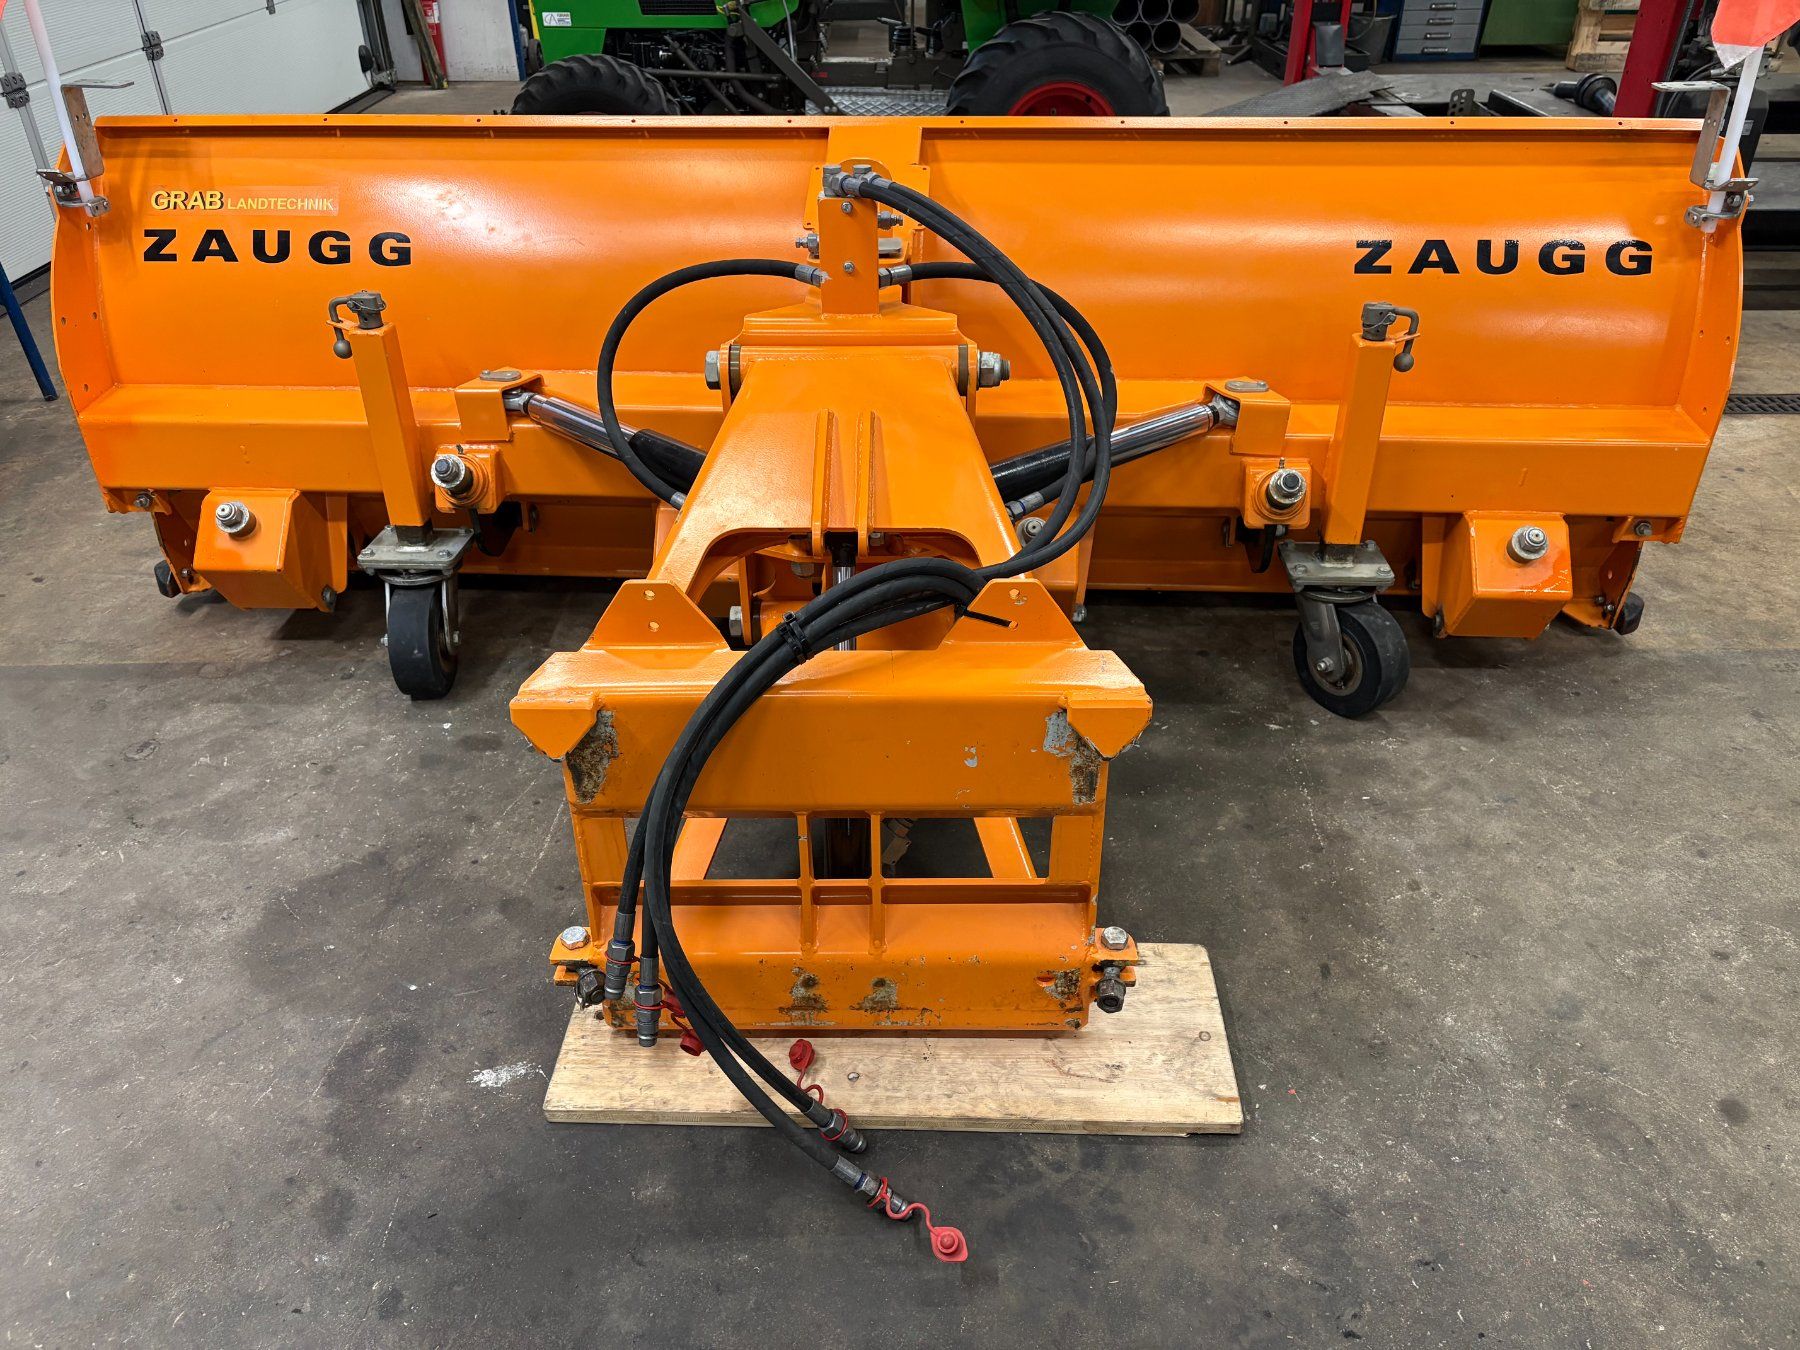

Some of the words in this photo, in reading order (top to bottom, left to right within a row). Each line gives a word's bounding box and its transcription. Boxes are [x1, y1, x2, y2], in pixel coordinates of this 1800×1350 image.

[151, 190, 224, 211] GRAB
[227, 197, 334, 212] LANDTECHNIK
[143, 229, 412, 267] ZAUGG
[1354, 239, 1653, 276] ZAUGG
